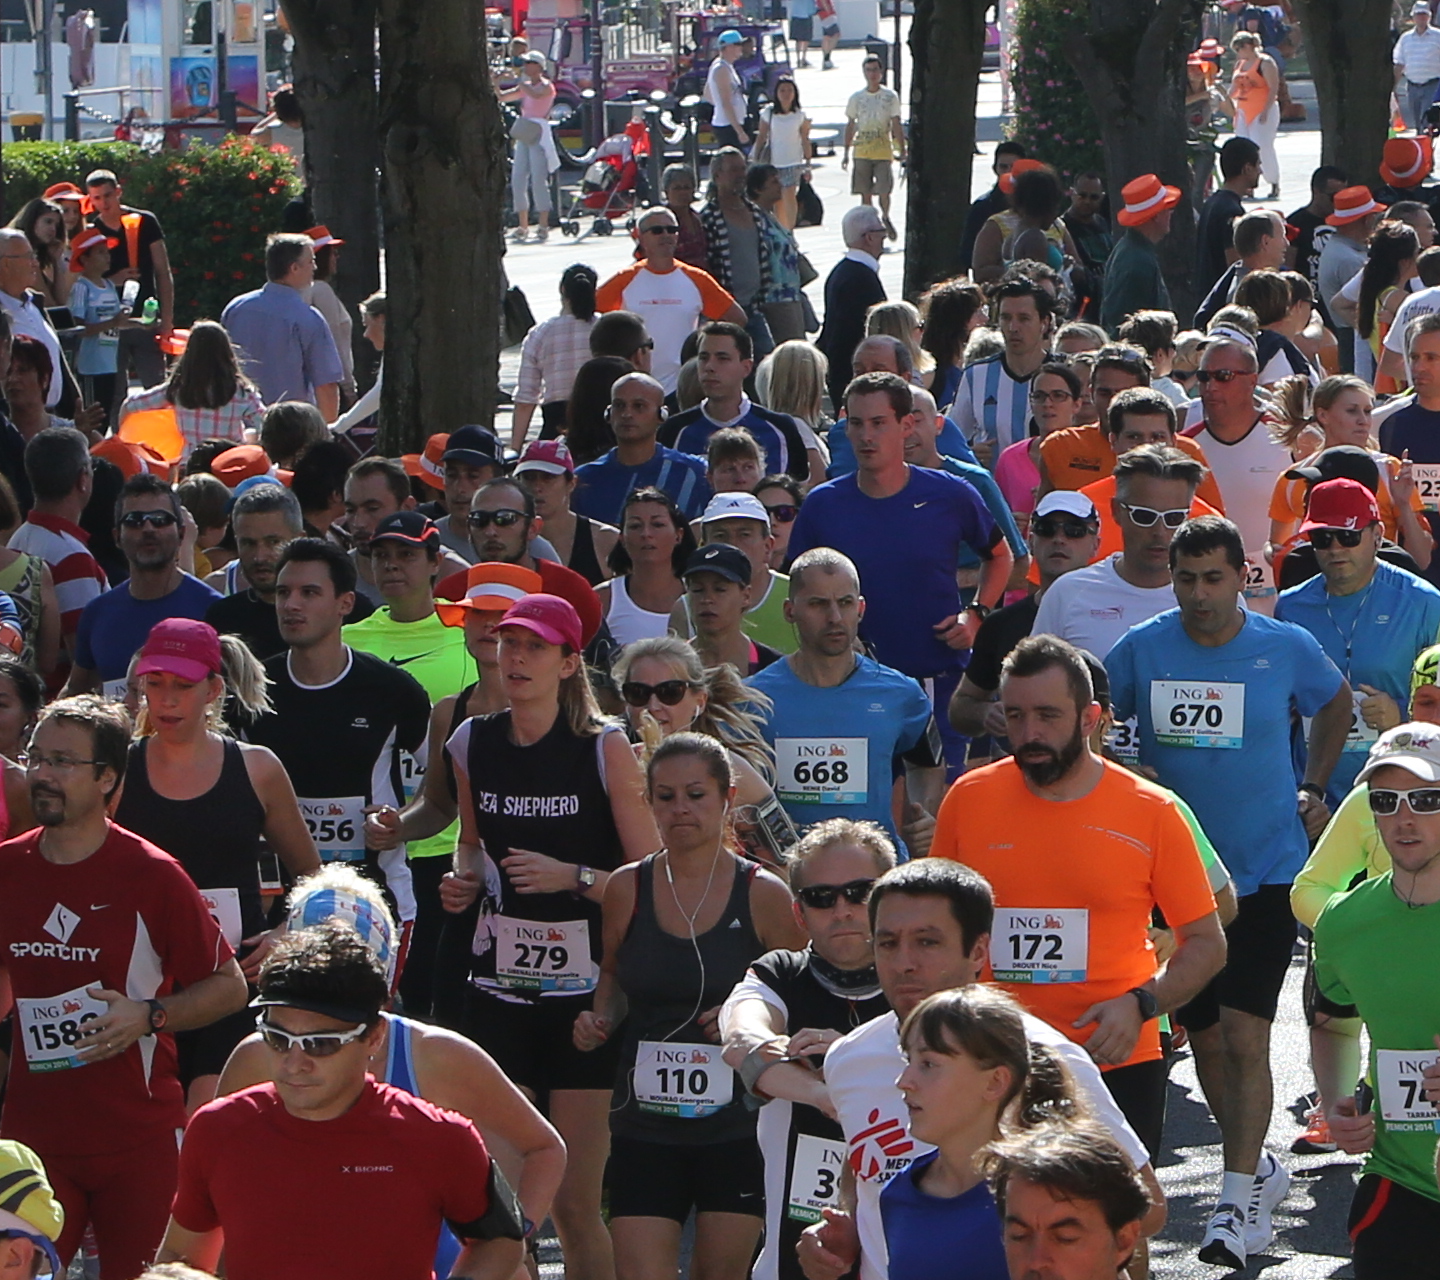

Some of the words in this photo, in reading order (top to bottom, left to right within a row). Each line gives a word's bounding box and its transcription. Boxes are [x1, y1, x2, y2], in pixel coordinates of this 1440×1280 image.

[1417, 470, 1438, 478] ING
[1173, 688, 1202, 700] ING
[1169, 704, 1223, 727] 670
[797, 746, 826, 758] ING
[794, 760, 849, 785] 668
[504, 791, 580, 818] SHEPHERD
[1009, 916, 1040, 929] ING
[516, 926, 544, 941] ING
[10, 941, 101, 963] SPORTCITY
[1009, 933, 1063, 961] 172
[514, 943, 569, 970] 279
[32, 1006, 60, 1021] ING
[656, 1050, 686, 1064] ING
[656, 1068, 709, 1095] 110
[1411, 1122, 1434, 1131] 2014
[354, 1165, 394, 1173] BIONIC
